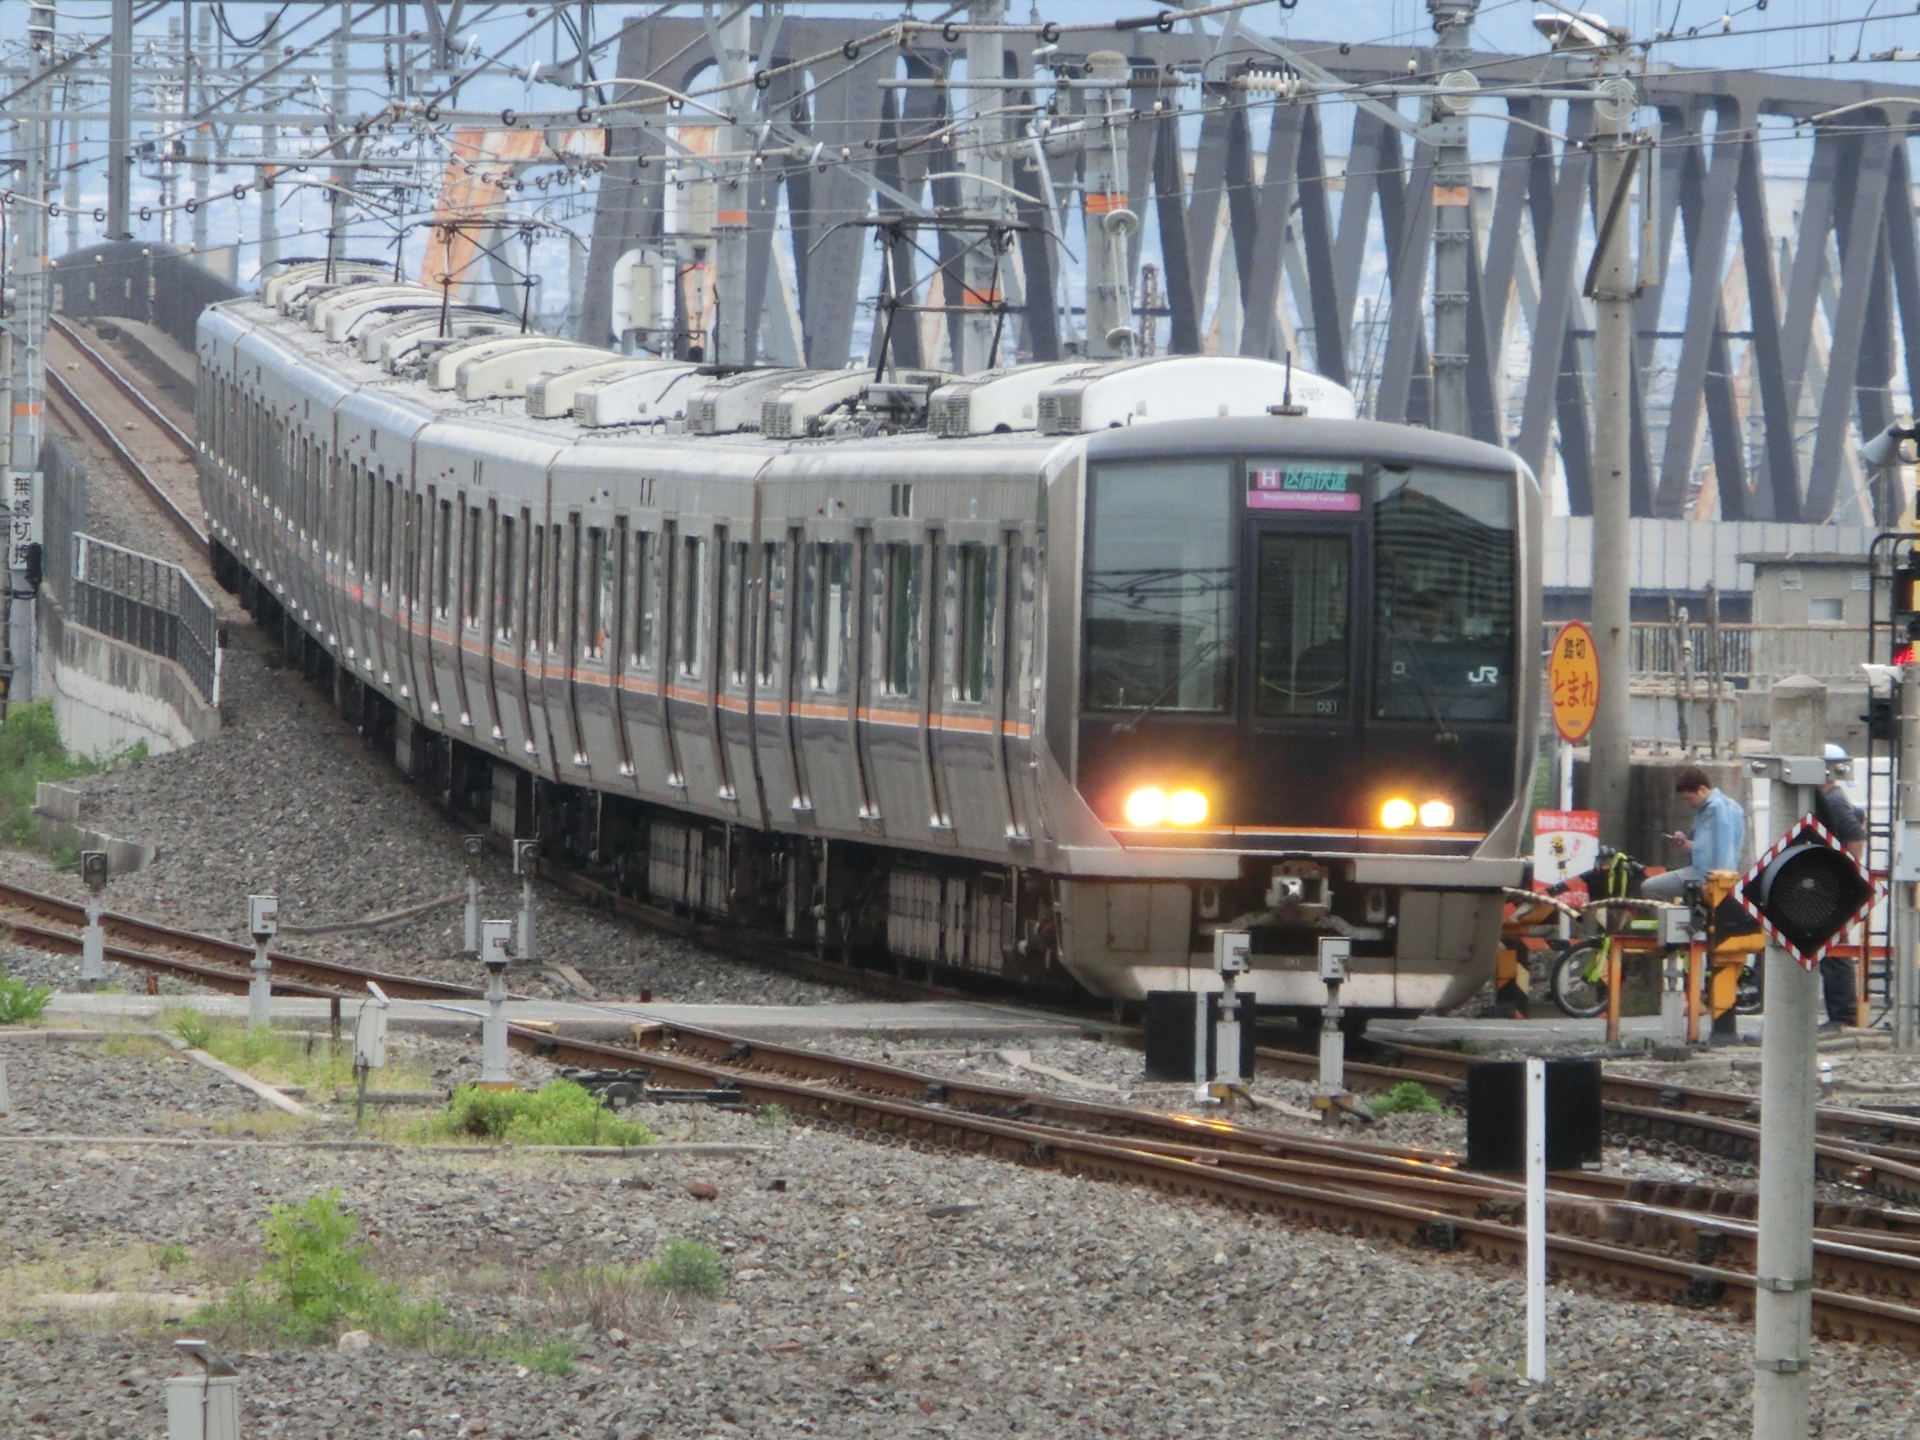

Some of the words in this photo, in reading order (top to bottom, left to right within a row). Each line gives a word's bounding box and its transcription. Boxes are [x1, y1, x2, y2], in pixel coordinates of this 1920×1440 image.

[1261, 470, 1277, 487] H
[1283, 466, 1348, 492] 区間快速
[1564, 638, 1586, 659] 踏切
[1468, 666, 1499, 684] JR
[1553, 669, 1596, 708] とまれ
